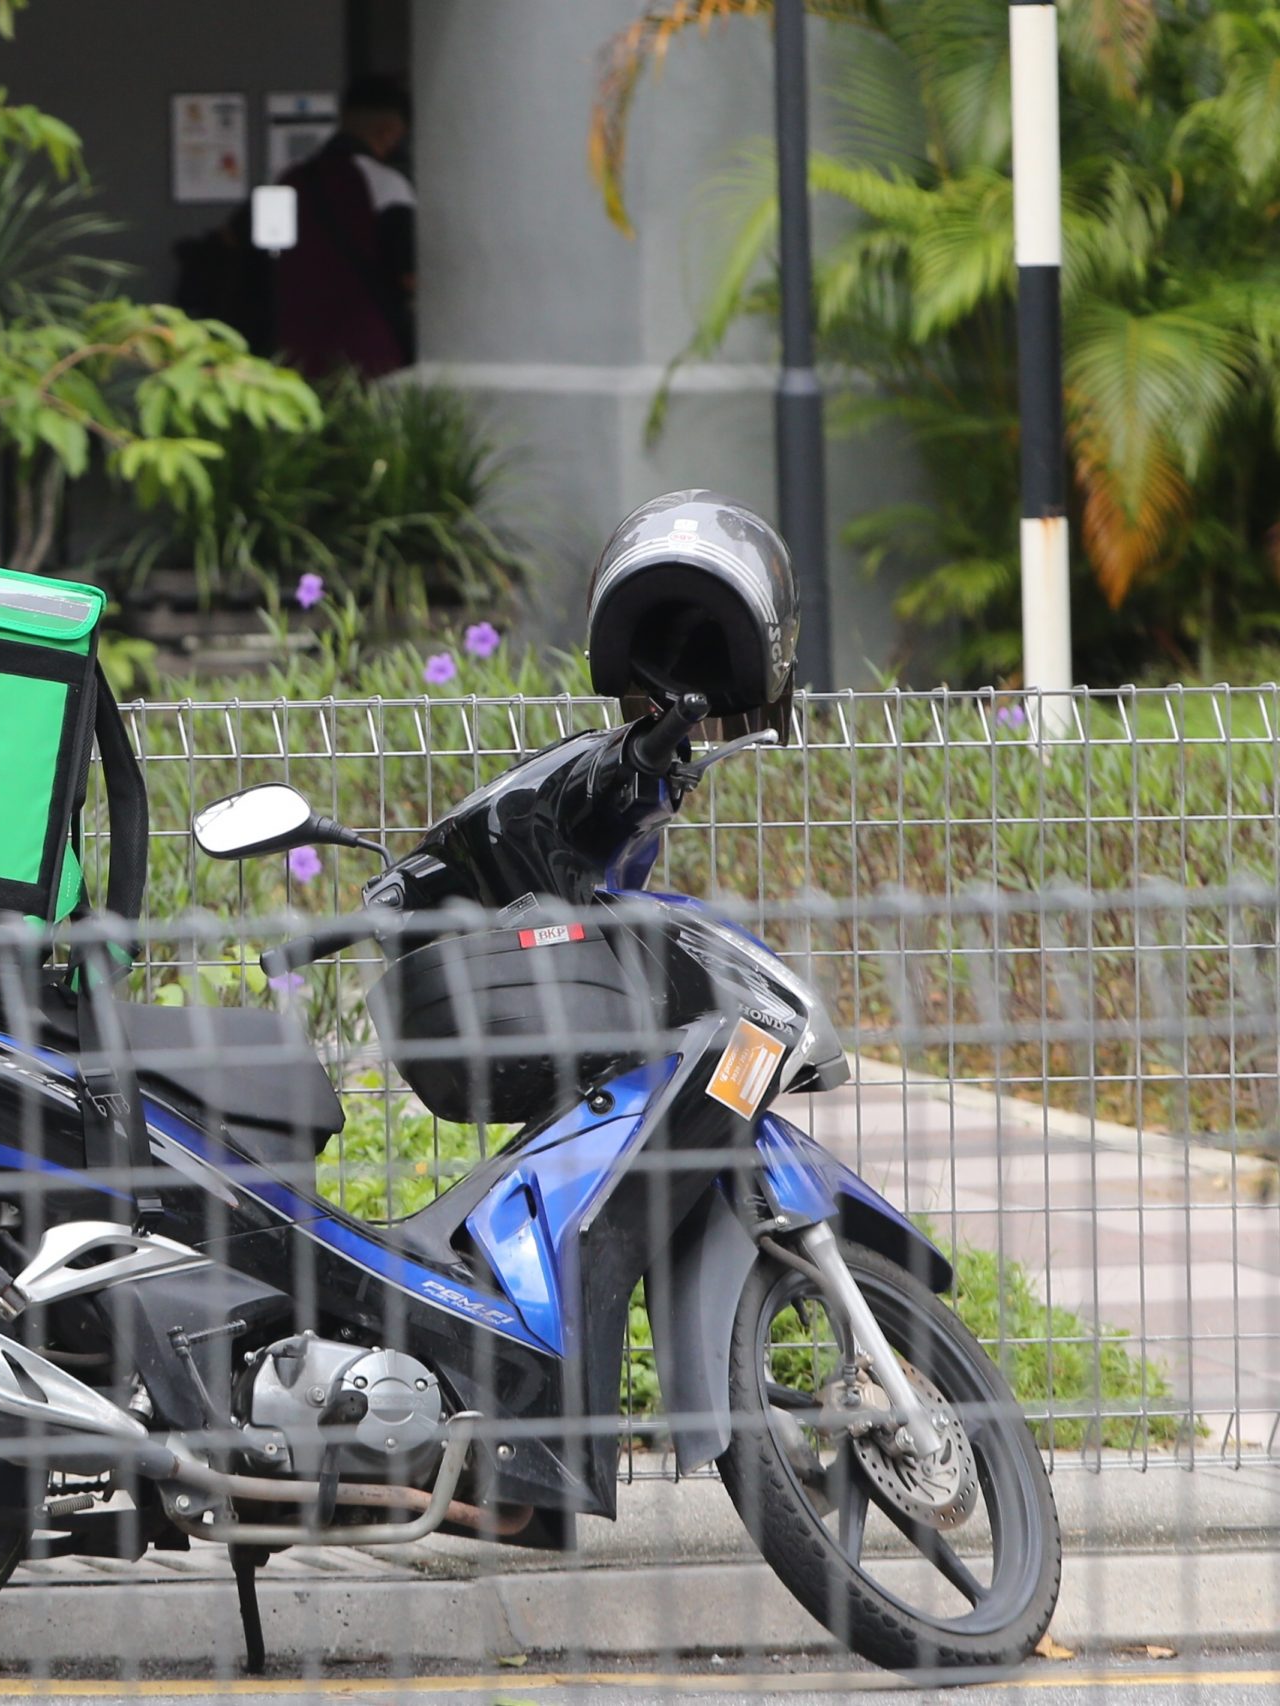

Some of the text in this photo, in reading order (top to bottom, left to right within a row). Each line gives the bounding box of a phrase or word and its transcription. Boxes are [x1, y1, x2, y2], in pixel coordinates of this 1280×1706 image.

[538, 927, 566, 940] BKP
[738, 1003, 794, 1036] HONDA
[422, 1280, 514, 1324] PGM-FI
